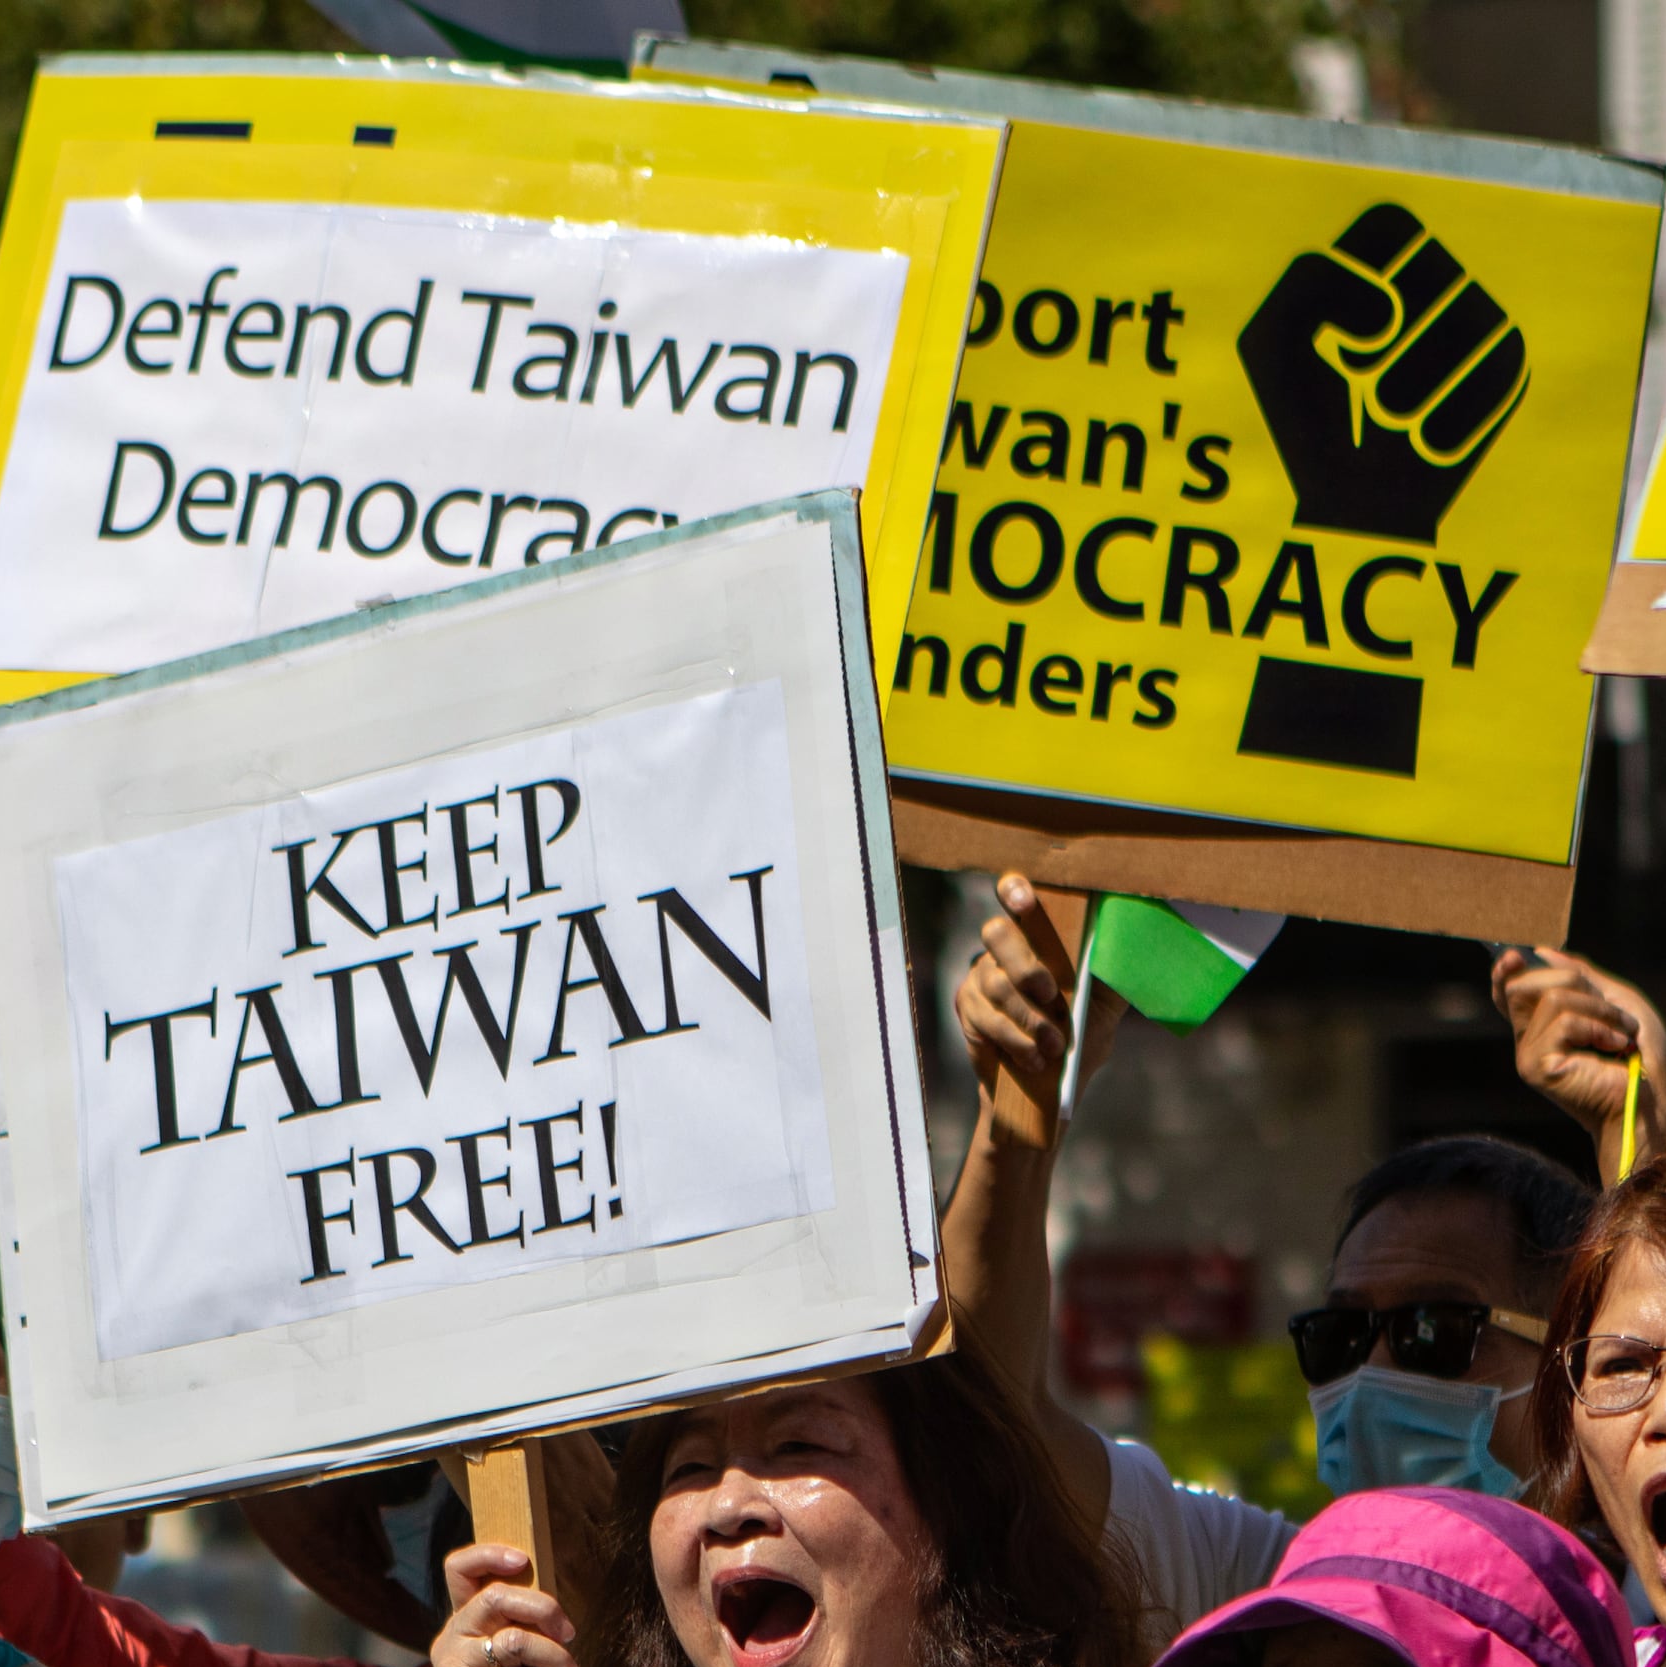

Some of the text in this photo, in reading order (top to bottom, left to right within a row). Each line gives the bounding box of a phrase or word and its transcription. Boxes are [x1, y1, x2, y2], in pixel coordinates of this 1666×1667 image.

[48, 266, 860, 434] Defend Taiwan
[97, 440, 679, 569] Democrac
[939, 400, 1232, 503] wan's
[926, 490, 1520, 671] OCRACY
[896, 622, 1180, 731] nders
[270, 776, 581, 958] KEEP
[104, 864, 774, 1155] TAIWAN
[287, 1100, 624, 1285] FREE!
